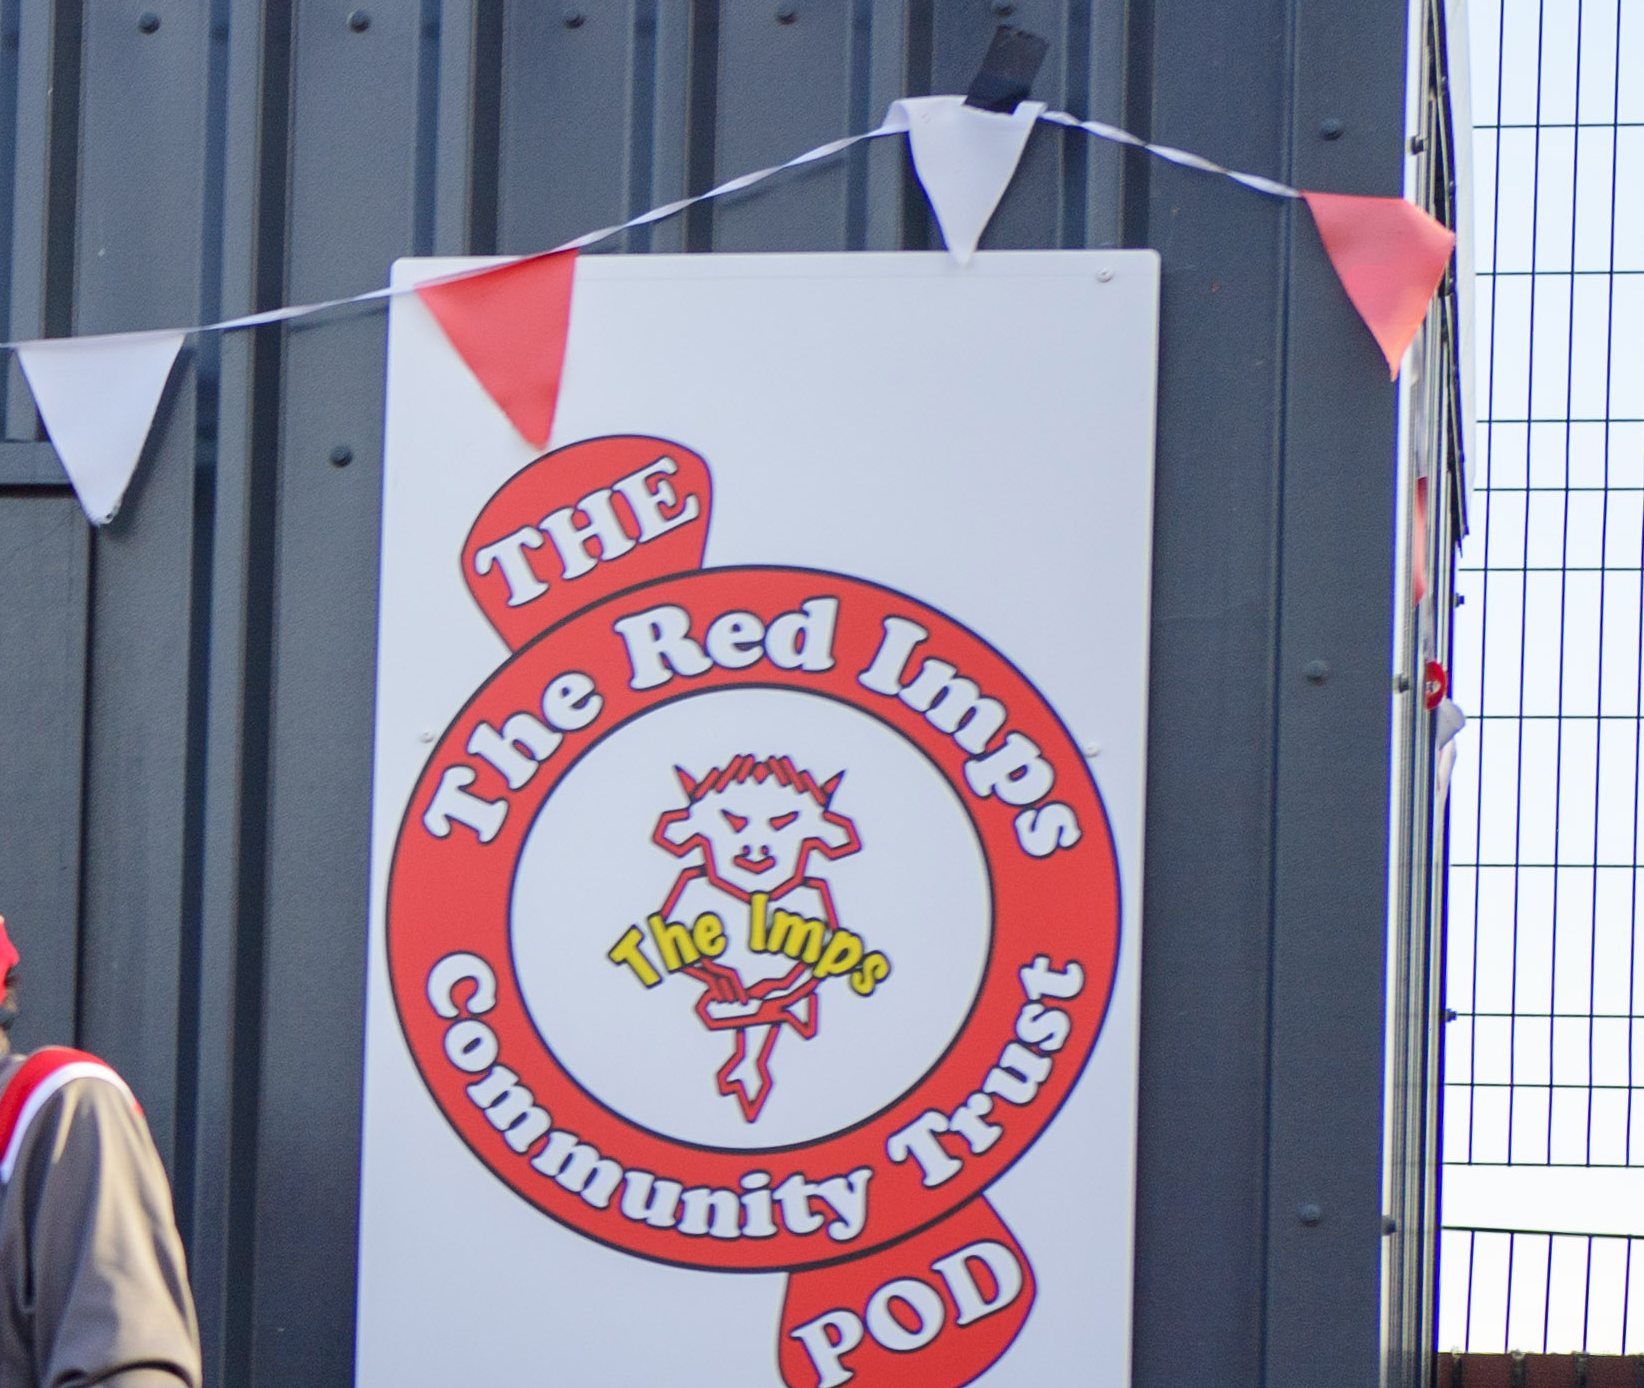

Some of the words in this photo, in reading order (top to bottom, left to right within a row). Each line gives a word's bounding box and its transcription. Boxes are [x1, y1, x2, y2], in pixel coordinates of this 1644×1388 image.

[474, 455, 701, 608] THE
[422, 669, 605, 844] The
[613, 595, 840, 691] Red
[857, 615, 1084, 860] Imps
[607, 911, 727, 992] The
[748, 891, 892, 998] Imps
[425, 950, 873, 1241] Community
[887, 954, 1086, 1188] Trust
